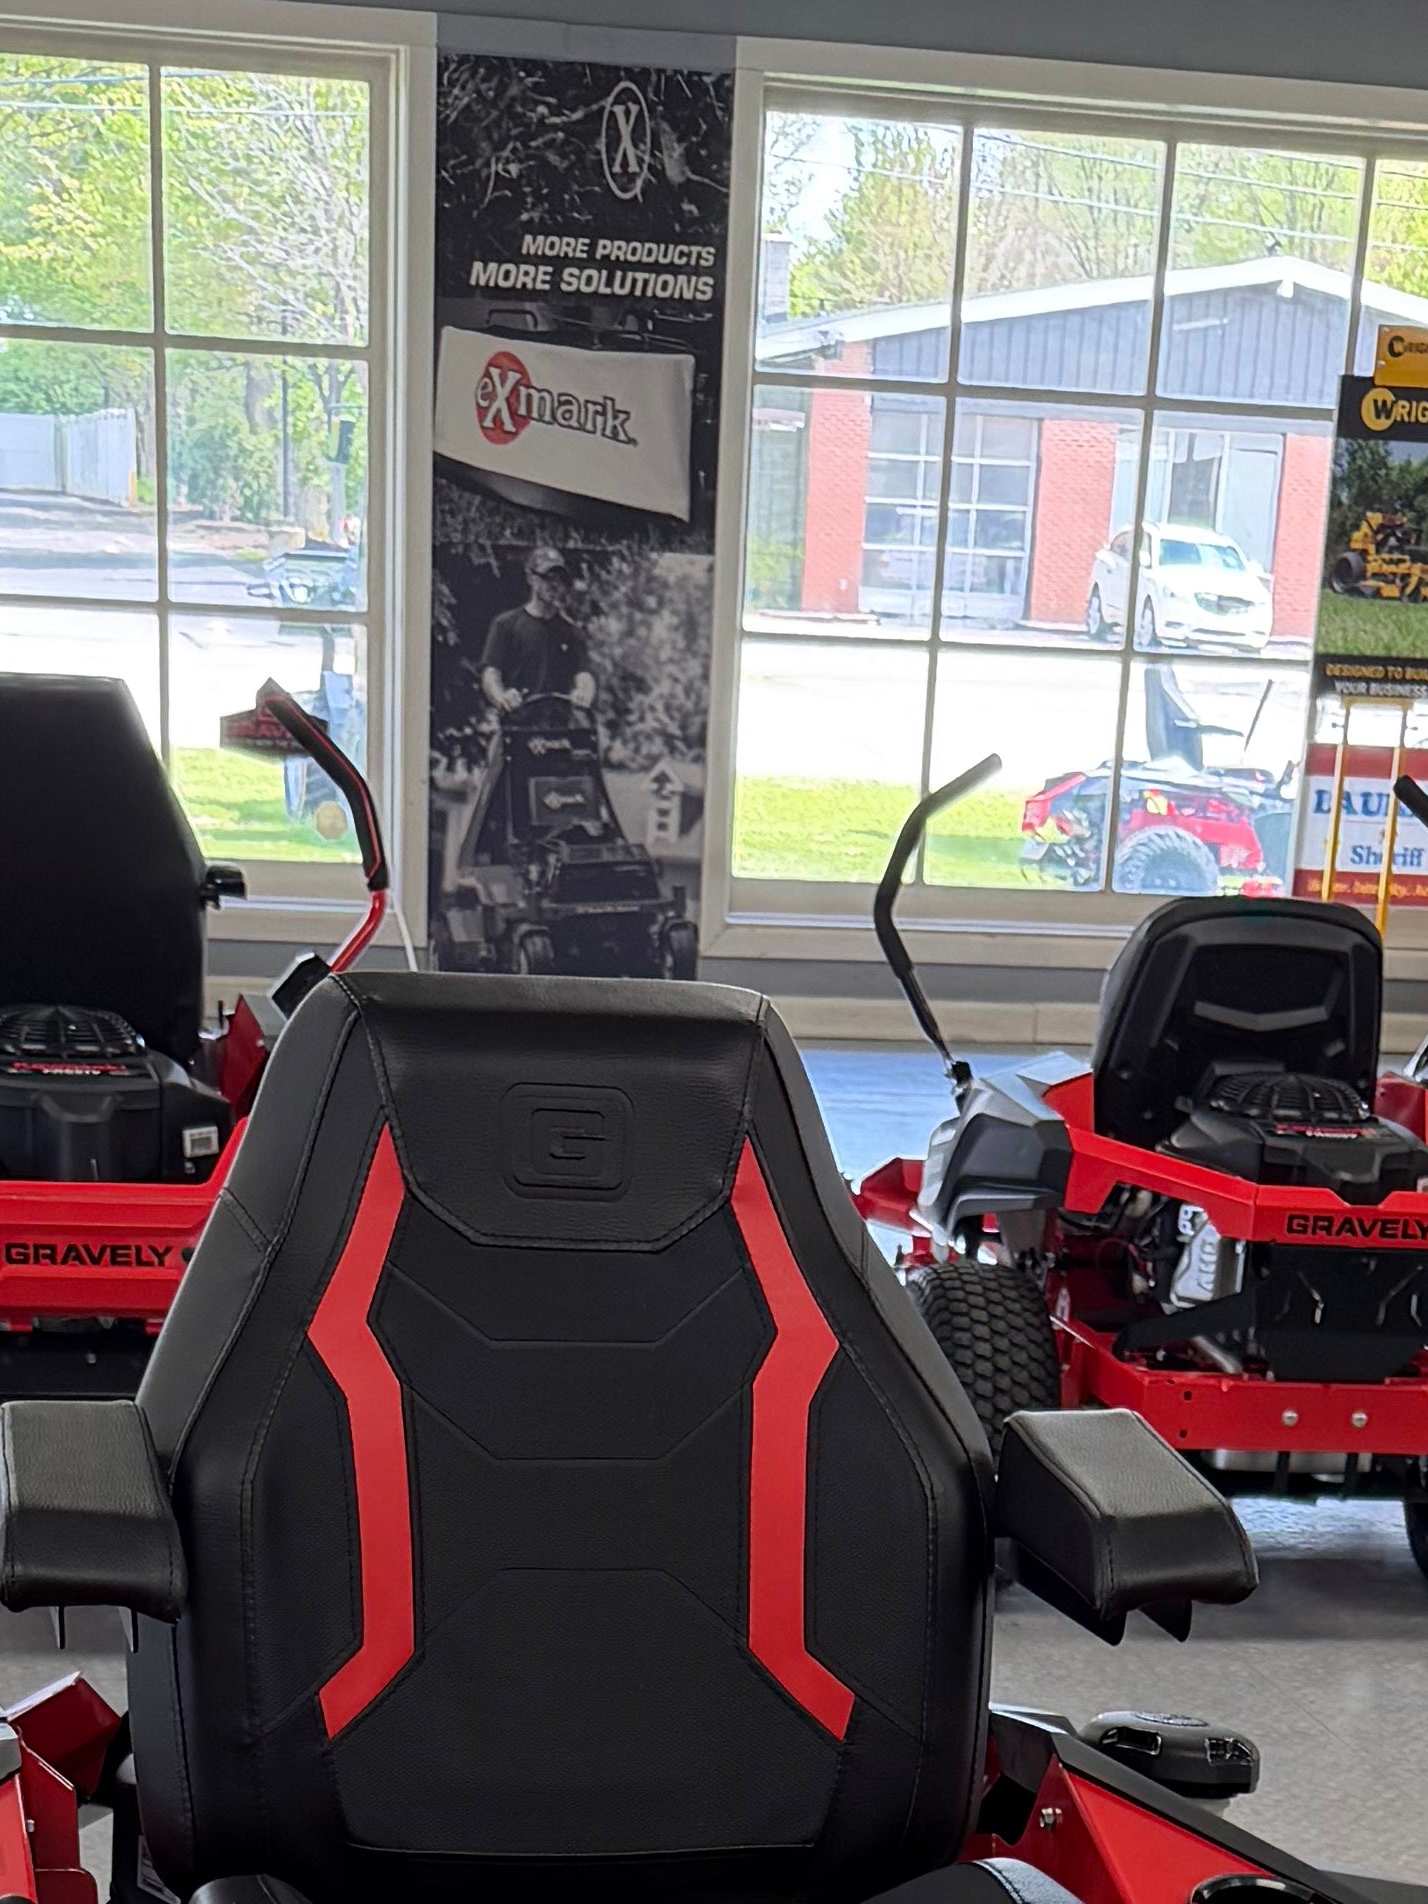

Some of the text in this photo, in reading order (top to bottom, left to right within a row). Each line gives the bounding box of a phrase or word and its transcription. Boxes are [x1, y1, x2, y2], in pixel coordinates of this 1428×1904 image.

[521, 234, 717, 267] MORE PRODUCTS
[469, 261, 715, 302] MORE SOLUTIONS
[1350, 845, 1425, 868] Shriff
[4, 1242, 173, 1268] GRAVELY
